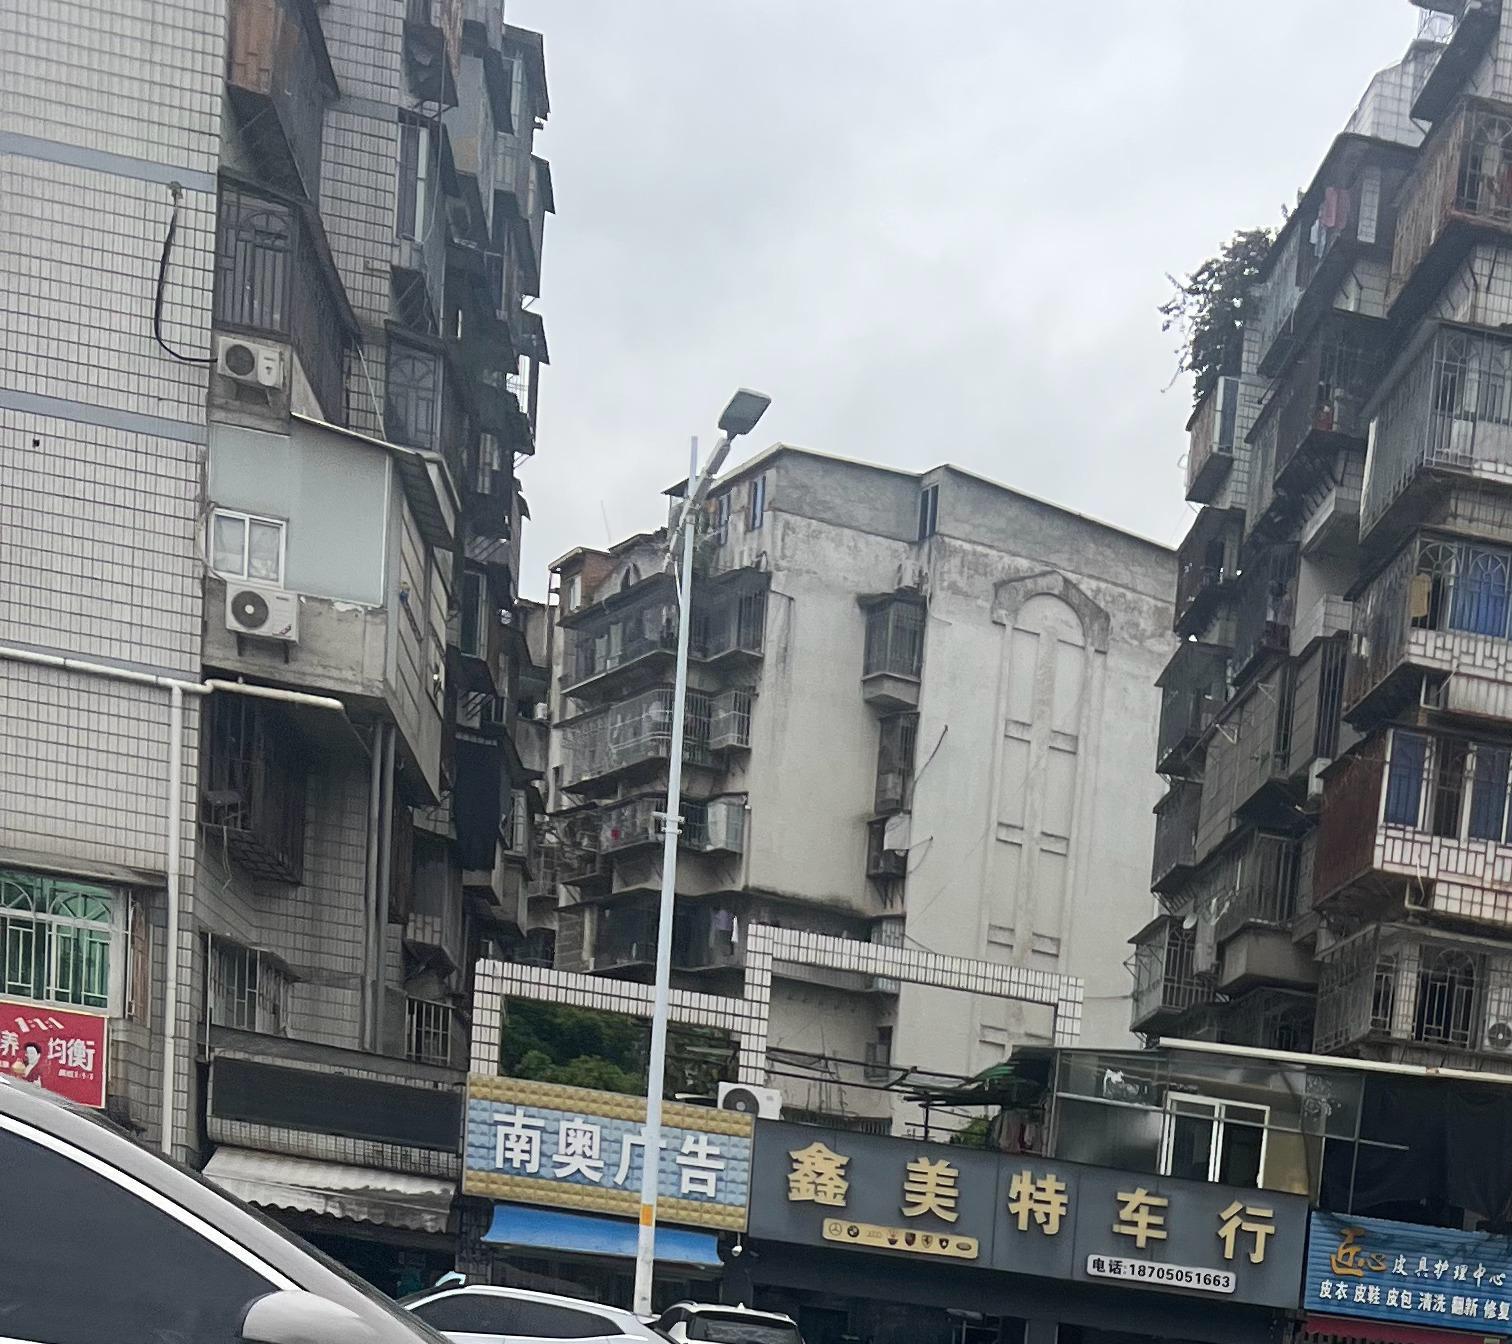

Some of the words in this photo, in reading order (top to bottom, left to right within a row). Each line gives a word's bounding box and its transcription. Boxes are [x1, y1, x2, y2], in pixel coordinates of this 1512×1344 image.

[47, 1037, 96, 1072] 均衡
[492, 1106, 726, 1198] 南奥广告
[787, 1141, 1276, 1265] 鑫美特车行
[1391, 1253, 1507, 1288] 皮具护理中心
[1319, 1278, 1349, 1301] 皮衣
[1353, 1282, 1381, 1305] 皮鞋
[1385, 1286, 1413, 1310] 皮包
[1417, 1291, 1447, 1313] 清洗
[1450, 1295, 1479, 1318] 翻新
[1483, 1298, 1511, 1321] 修复
